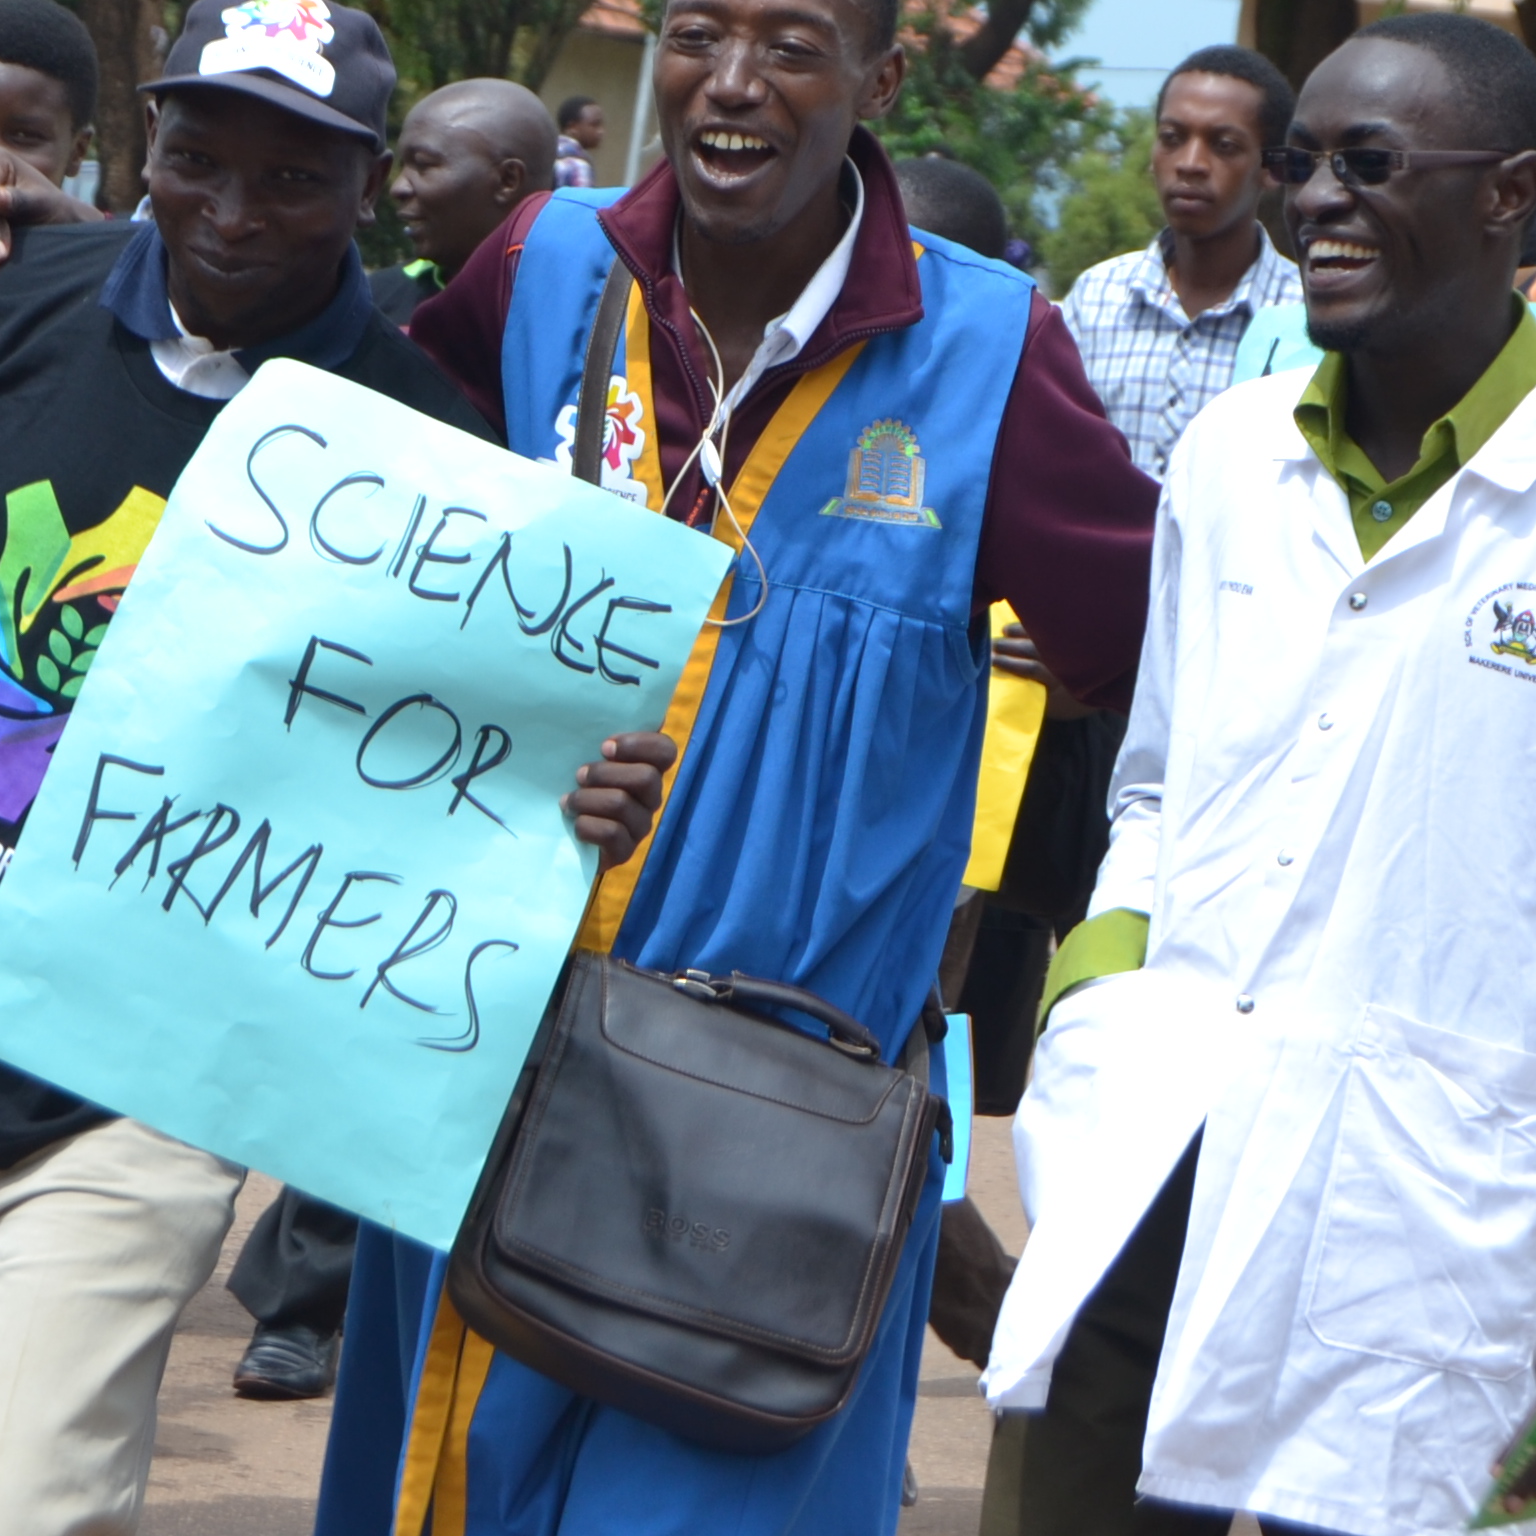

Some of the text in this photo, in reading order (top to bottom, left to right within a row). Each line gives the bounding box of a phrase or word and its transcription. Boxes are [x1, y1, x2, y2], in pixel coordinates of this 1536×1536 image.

[205, 423, 672, 686] SCIENCE
[285, 635, 518, 840] FOR
[1469, 655, 1513, 676] MAKERERE
[68, 750, 519, 1052] FARMERS
[643, 1207, 731, 1252] BOSS
